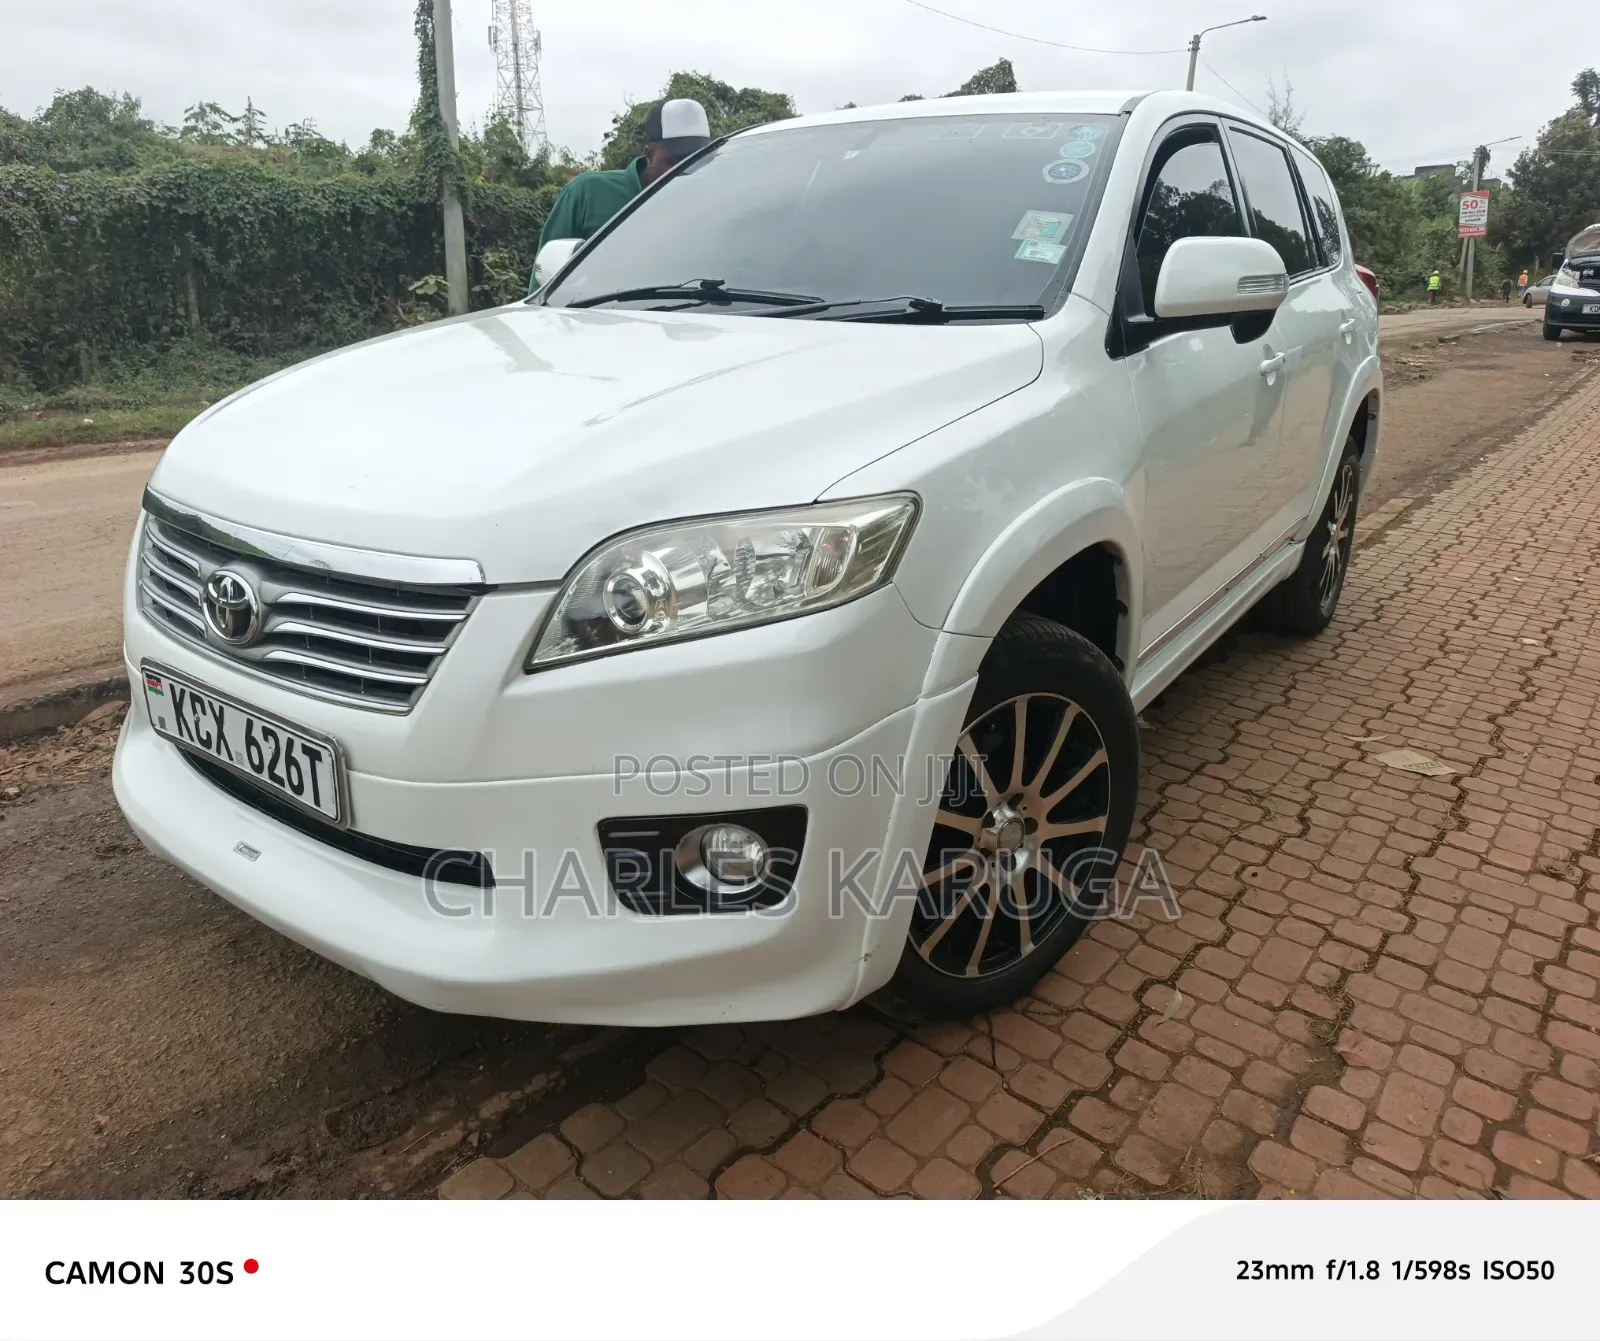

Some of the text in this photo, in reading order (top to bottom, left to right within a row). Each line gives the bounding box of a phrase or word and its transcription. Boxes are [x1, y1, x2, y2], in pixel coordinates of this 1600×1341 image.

[1462, 200, 1478, 210] 50
[169, 682, 234, 762] KCX
[244, 716, 323, 808] 626T
